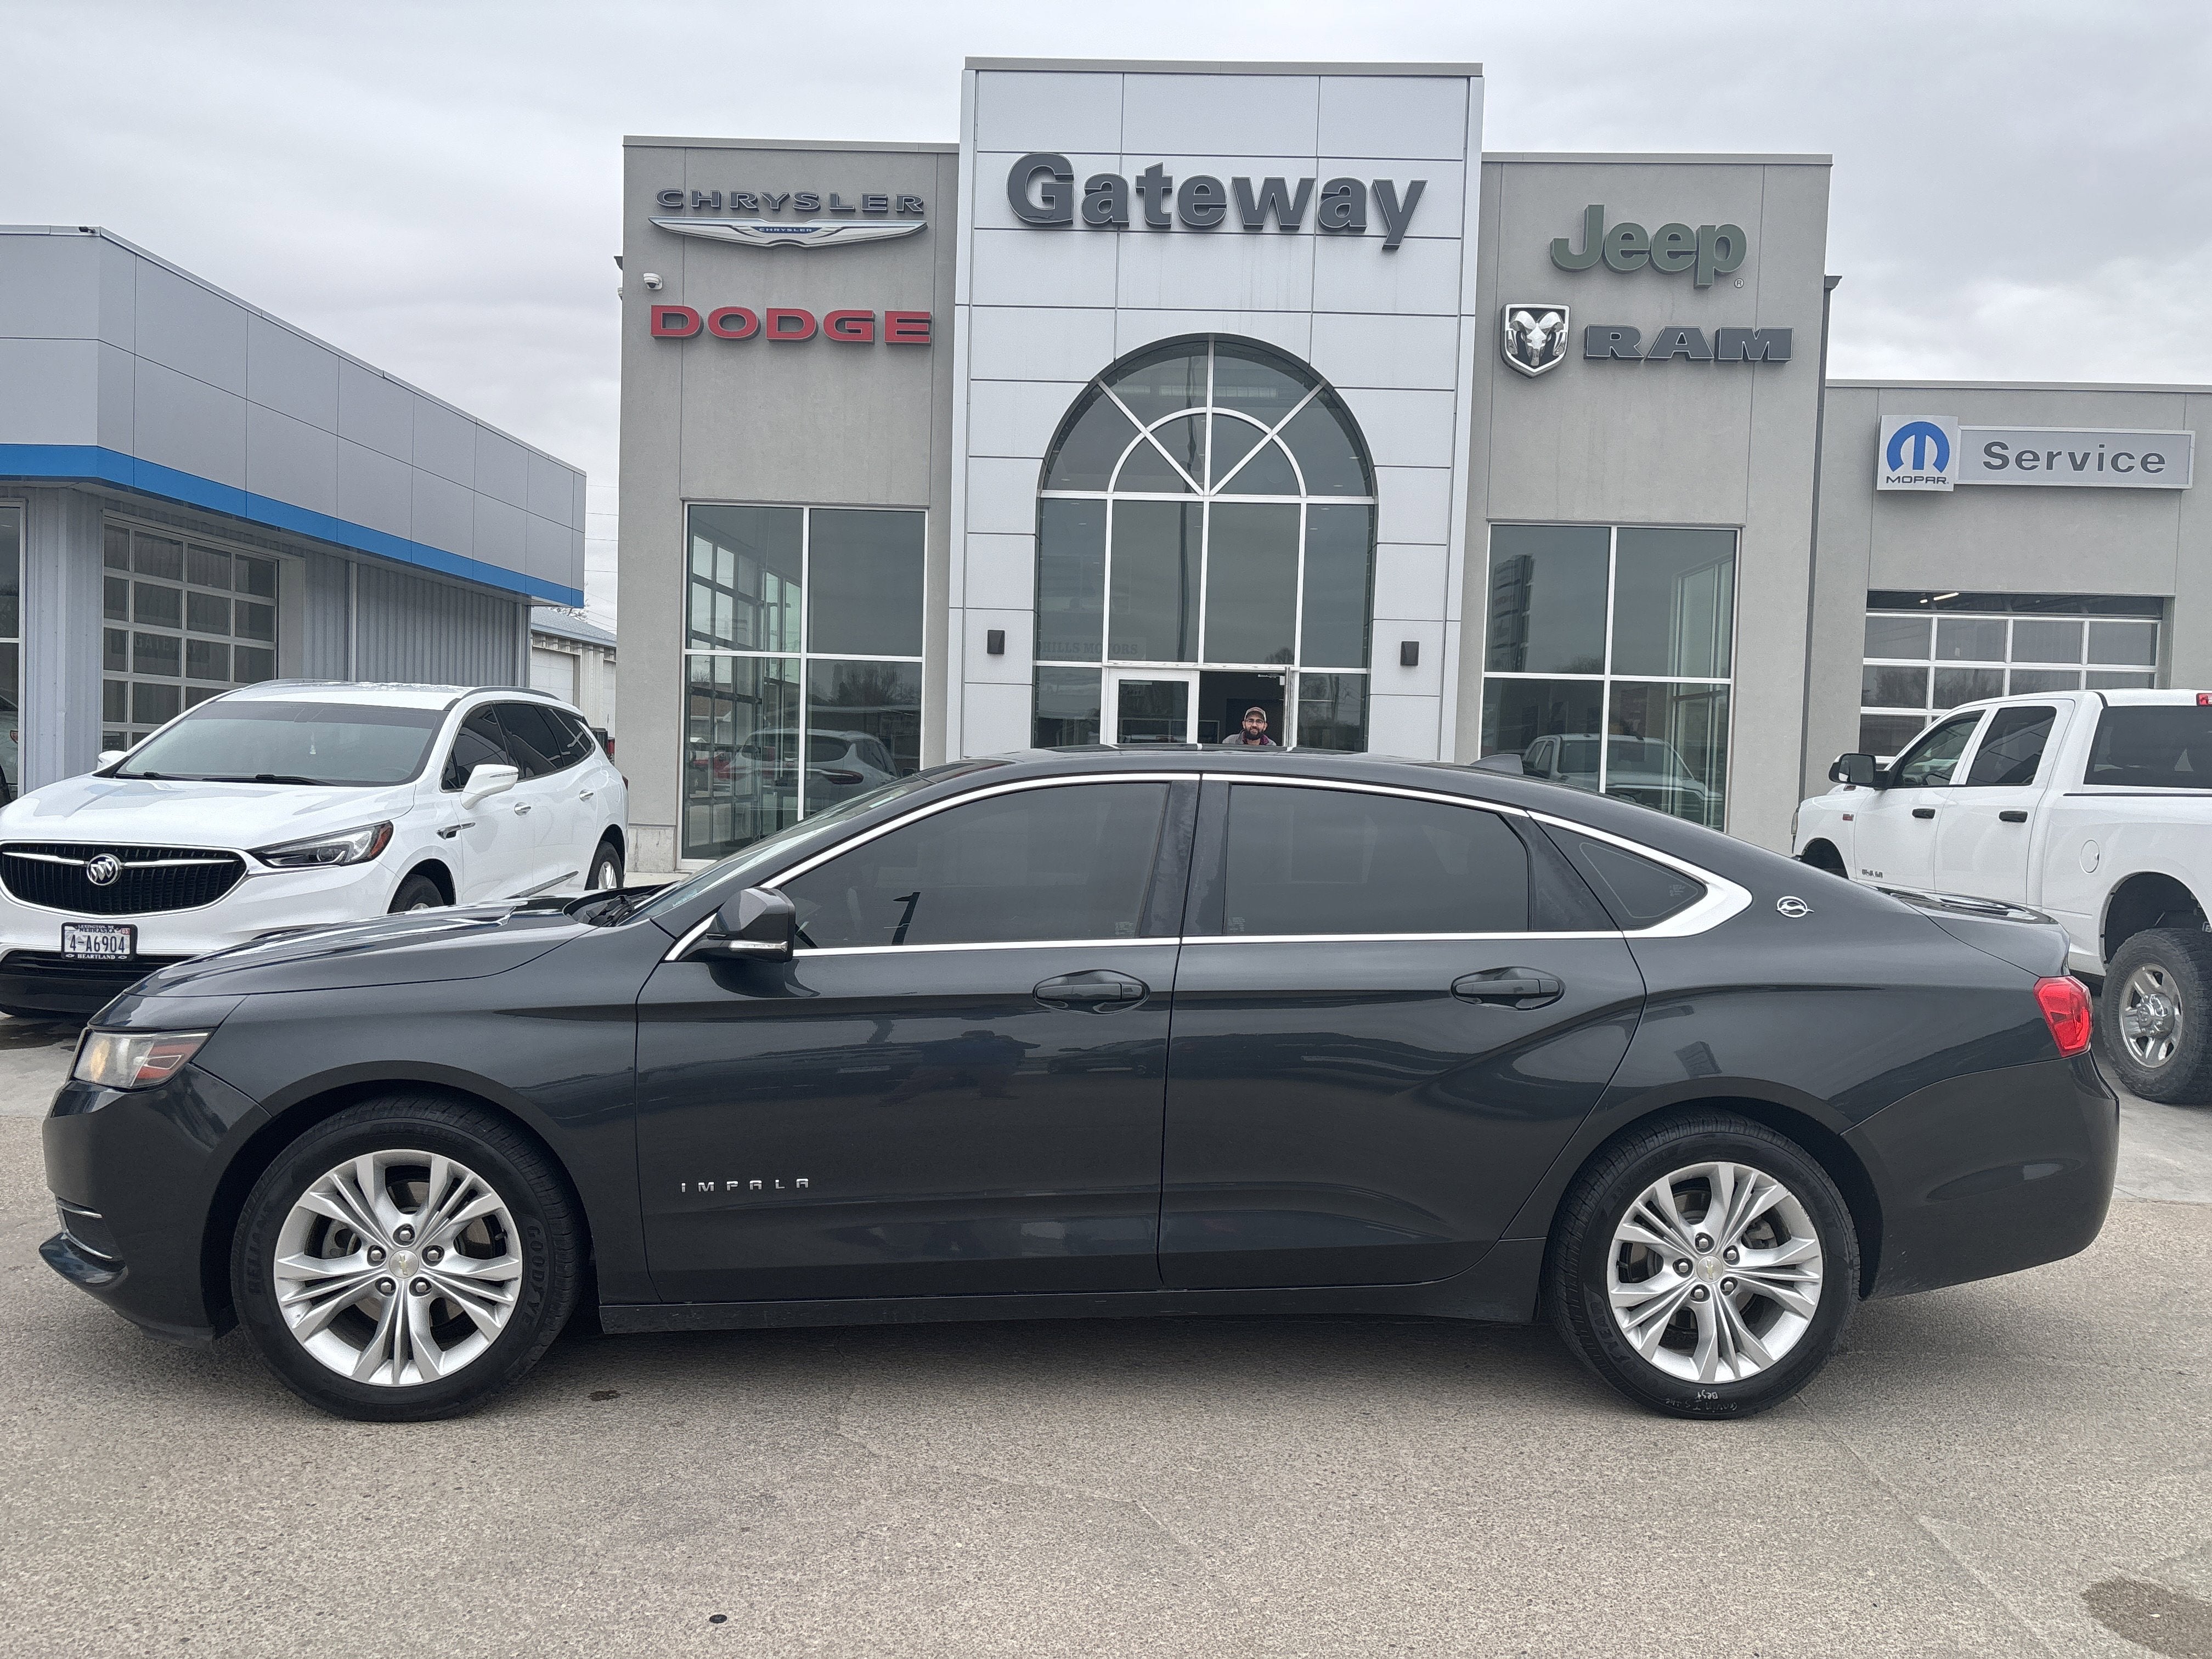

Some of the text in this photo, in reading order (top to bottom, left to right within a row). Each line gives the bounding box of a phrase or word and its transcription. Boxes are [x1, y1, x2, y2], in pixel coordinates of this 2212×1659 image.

[655, 188, 924, 213] CHRYSLER
[1006, 152, 1429, 250] Gateway
[1550, 204, 1747, 288] Jeep
[651, 304, 932, 344] DODGE
[1584, 324, 1794, 362] RAM
[1983, 441, 2166, 473] Service
[1886, 475, 1948, 485] MOPAR
[70, 934, 125, 953] 4-A6904
[681, 1178, 809, 1193] IMPALA
